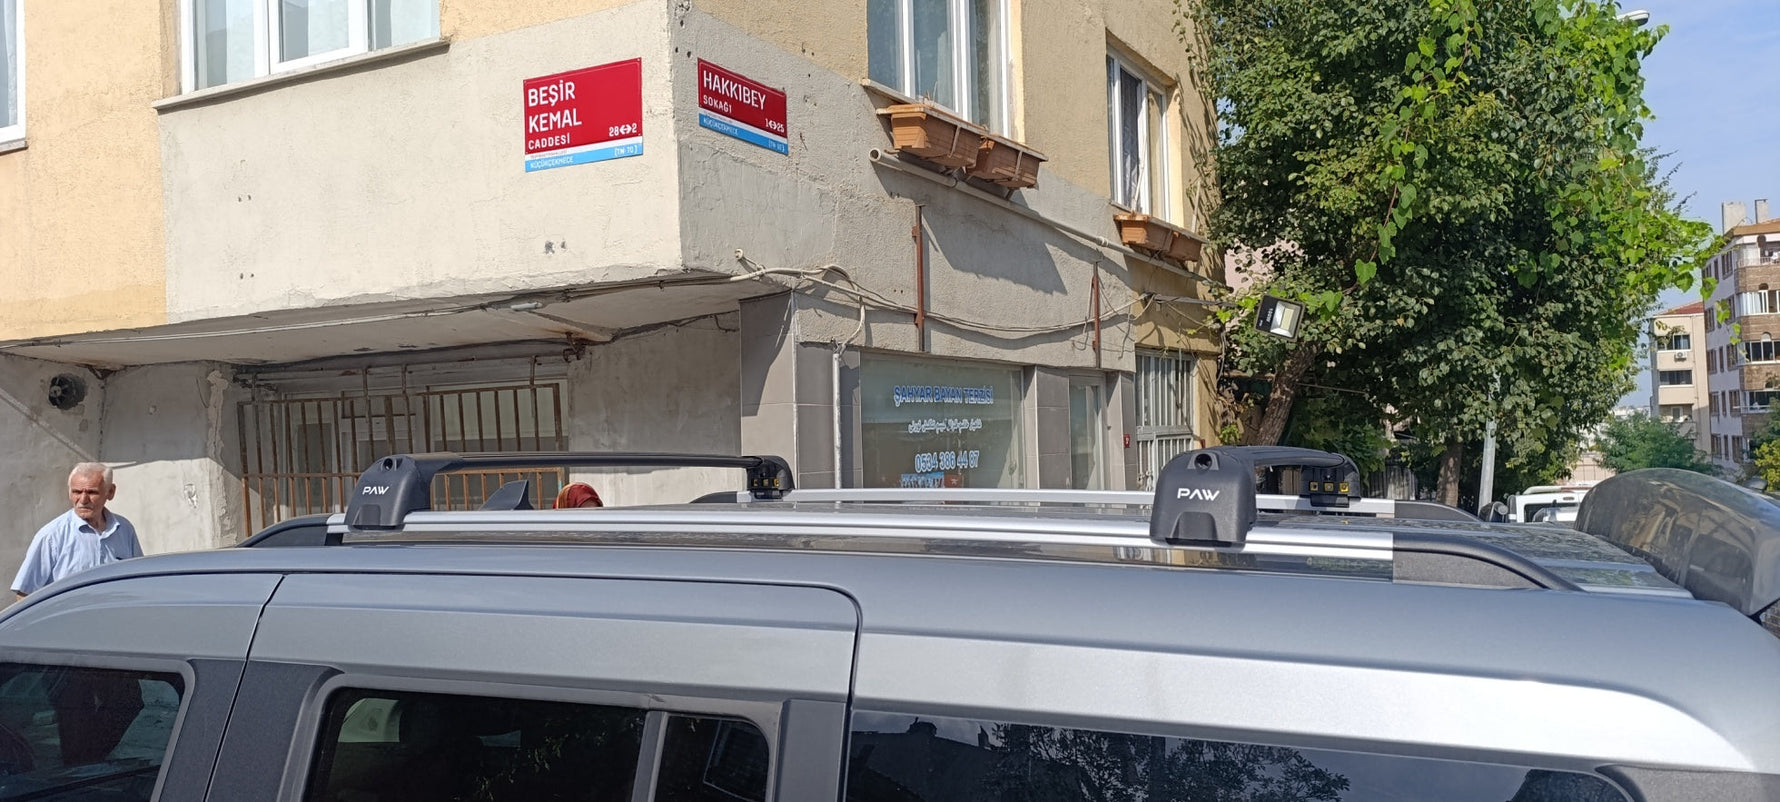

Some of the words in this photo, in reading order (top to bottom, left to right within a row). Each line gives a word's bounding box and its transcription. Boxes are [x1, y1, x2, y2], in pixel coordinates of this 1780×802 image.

[528, 80, 575, 107] BEŞİR
[703, 70, 766, 110] HAKKIBEY
[703, 94, 732, 114] SOKAĞI
[529, 108, 582, 133] KEMAL
[609, 126, 620, 137] 28
[632, 123, 637, 133] 2
[528, 133, 570, 150] CADDESİ
[894, 386, 933, 407] ŞAHYAR
[933, 386, 962, 404] BAYAN
[962, 386, 994, 404] TERZİSİ
[915, 453, 938, 473] 0534
[939, 451, 956, 470] 386
[957, 450, 968, 468] 44
[969, 450, 980, 468] 87
[362, 486, 389, 495] PAW
[1177, 488, 1219, 501] PAW
